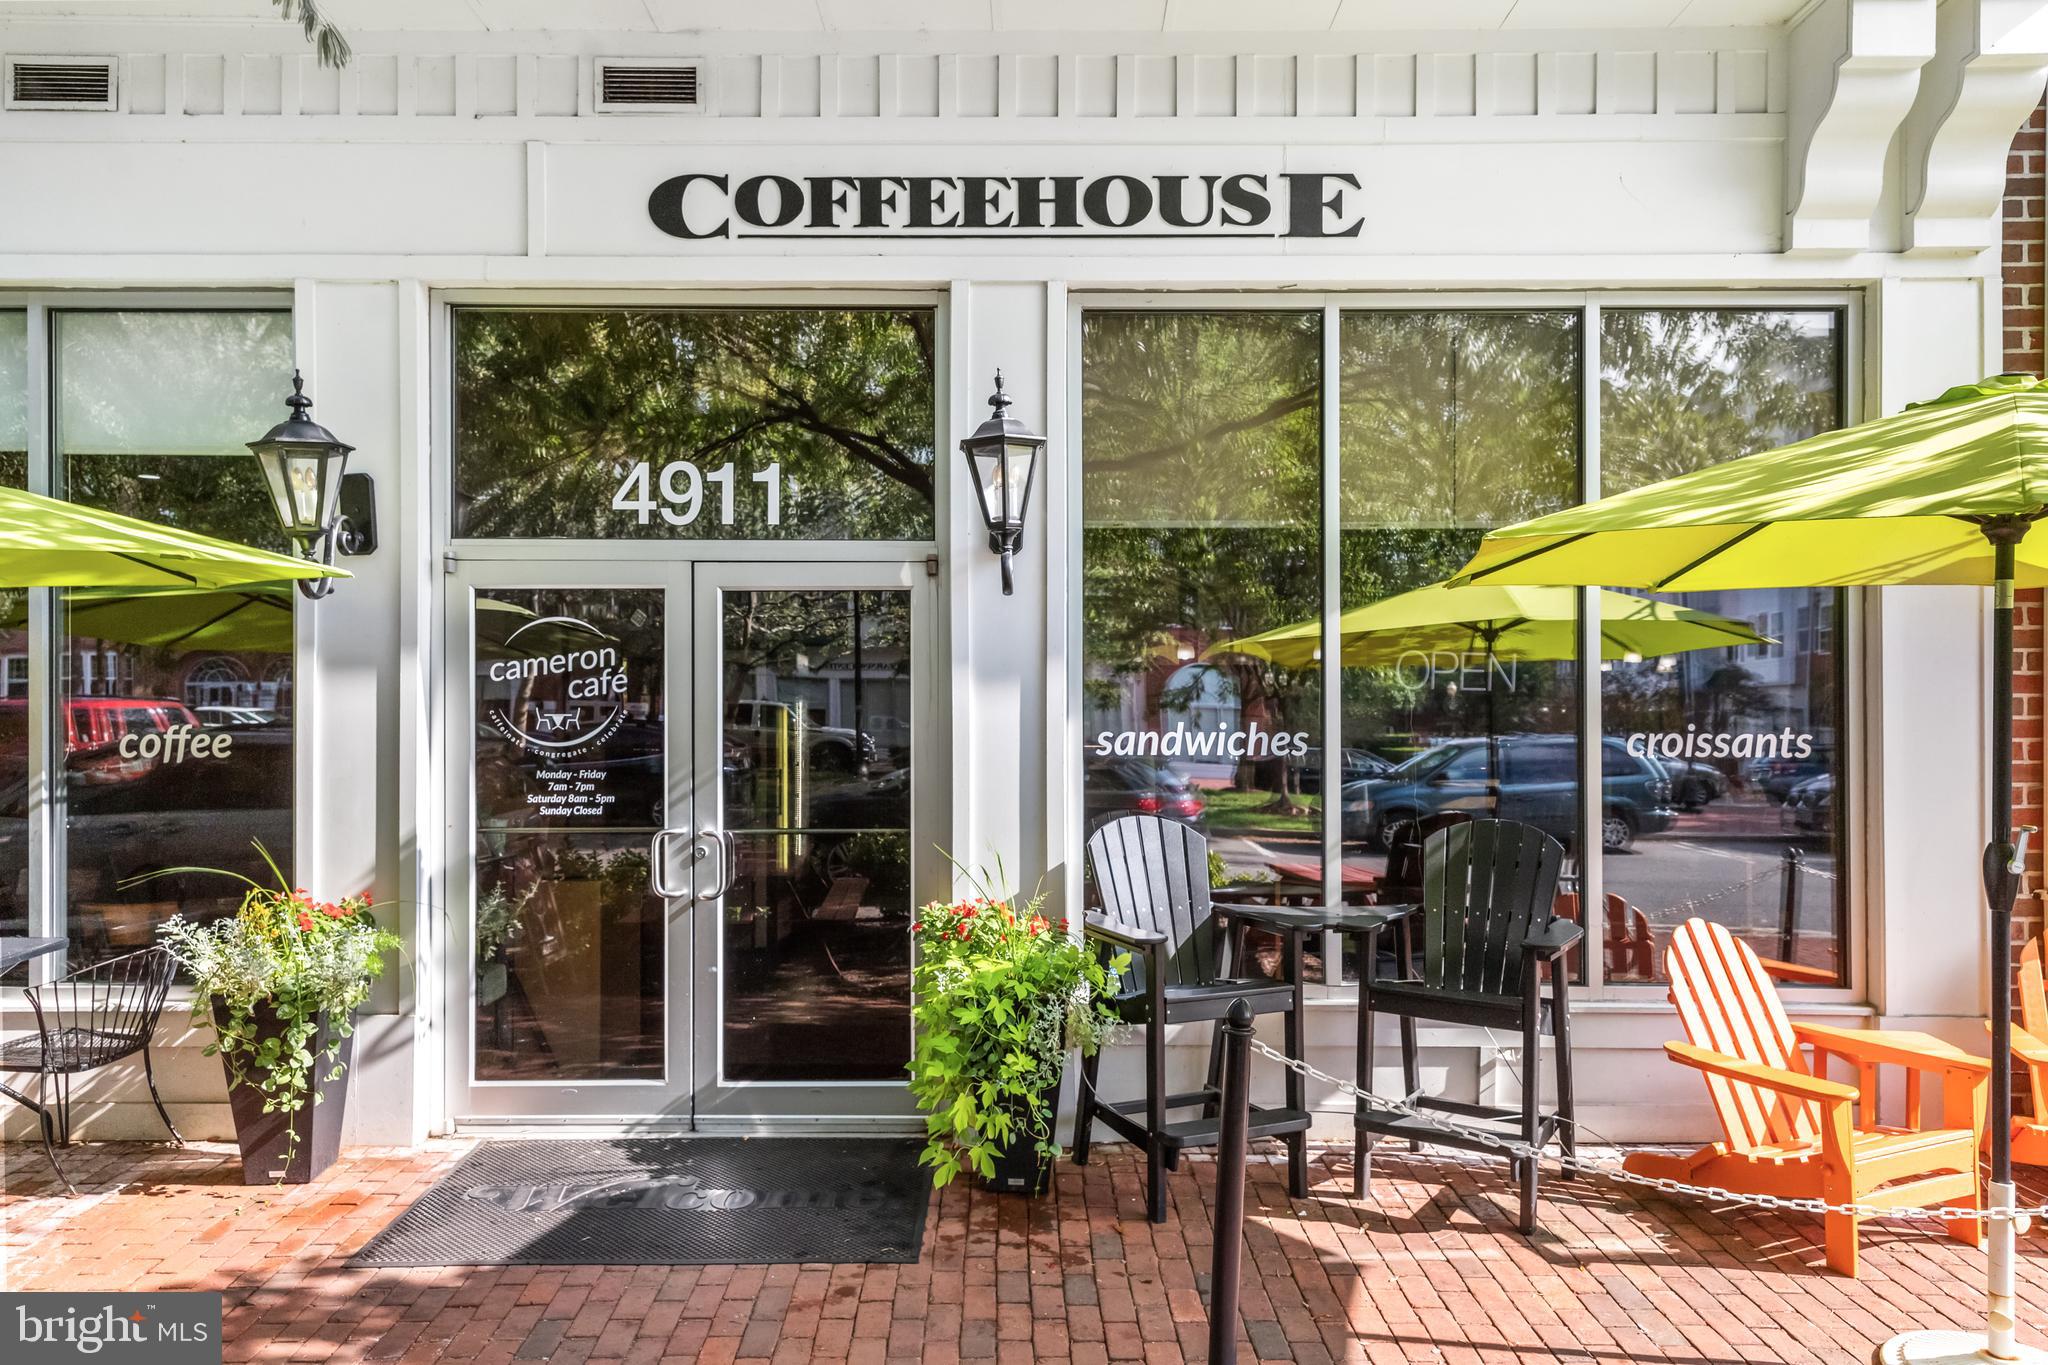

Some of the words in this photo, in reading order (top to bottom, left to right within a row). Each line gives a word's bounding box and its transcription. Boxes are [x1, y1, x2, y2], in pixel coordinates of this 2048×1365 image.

[648, 173, 1365, 239] COFFEEHOUSE
[612, 460, 780, 526] 4911
[489, 647, 616, 682] cameron
[1396, 650, 1517, 692] OPEN
[568, 666, 628, 699] café
[119, 724, 233, 764] coffee
[489, 709, 526, 748] caffeinate
[534, 749, 588, 758] congregate
[596, 709, 629, 746] celebrate
[1095, 721, 1310, 756] sandwiches
[1626, 723, 1813, 759] croissants
[536, 770, 573, 780] Monday
[579, 770, 607, 780] Friday
[547, 782, 568, 791] 7am
[575, 782, 595, 792] 7pm
[526, 794, 567, 804] Saturday
[568, 794, 588, 803] 8am
[595, 794, 615, 804] 5pm
[539, 806, 573, 816] Sunday
[573, 806, 603, 815] Closed
